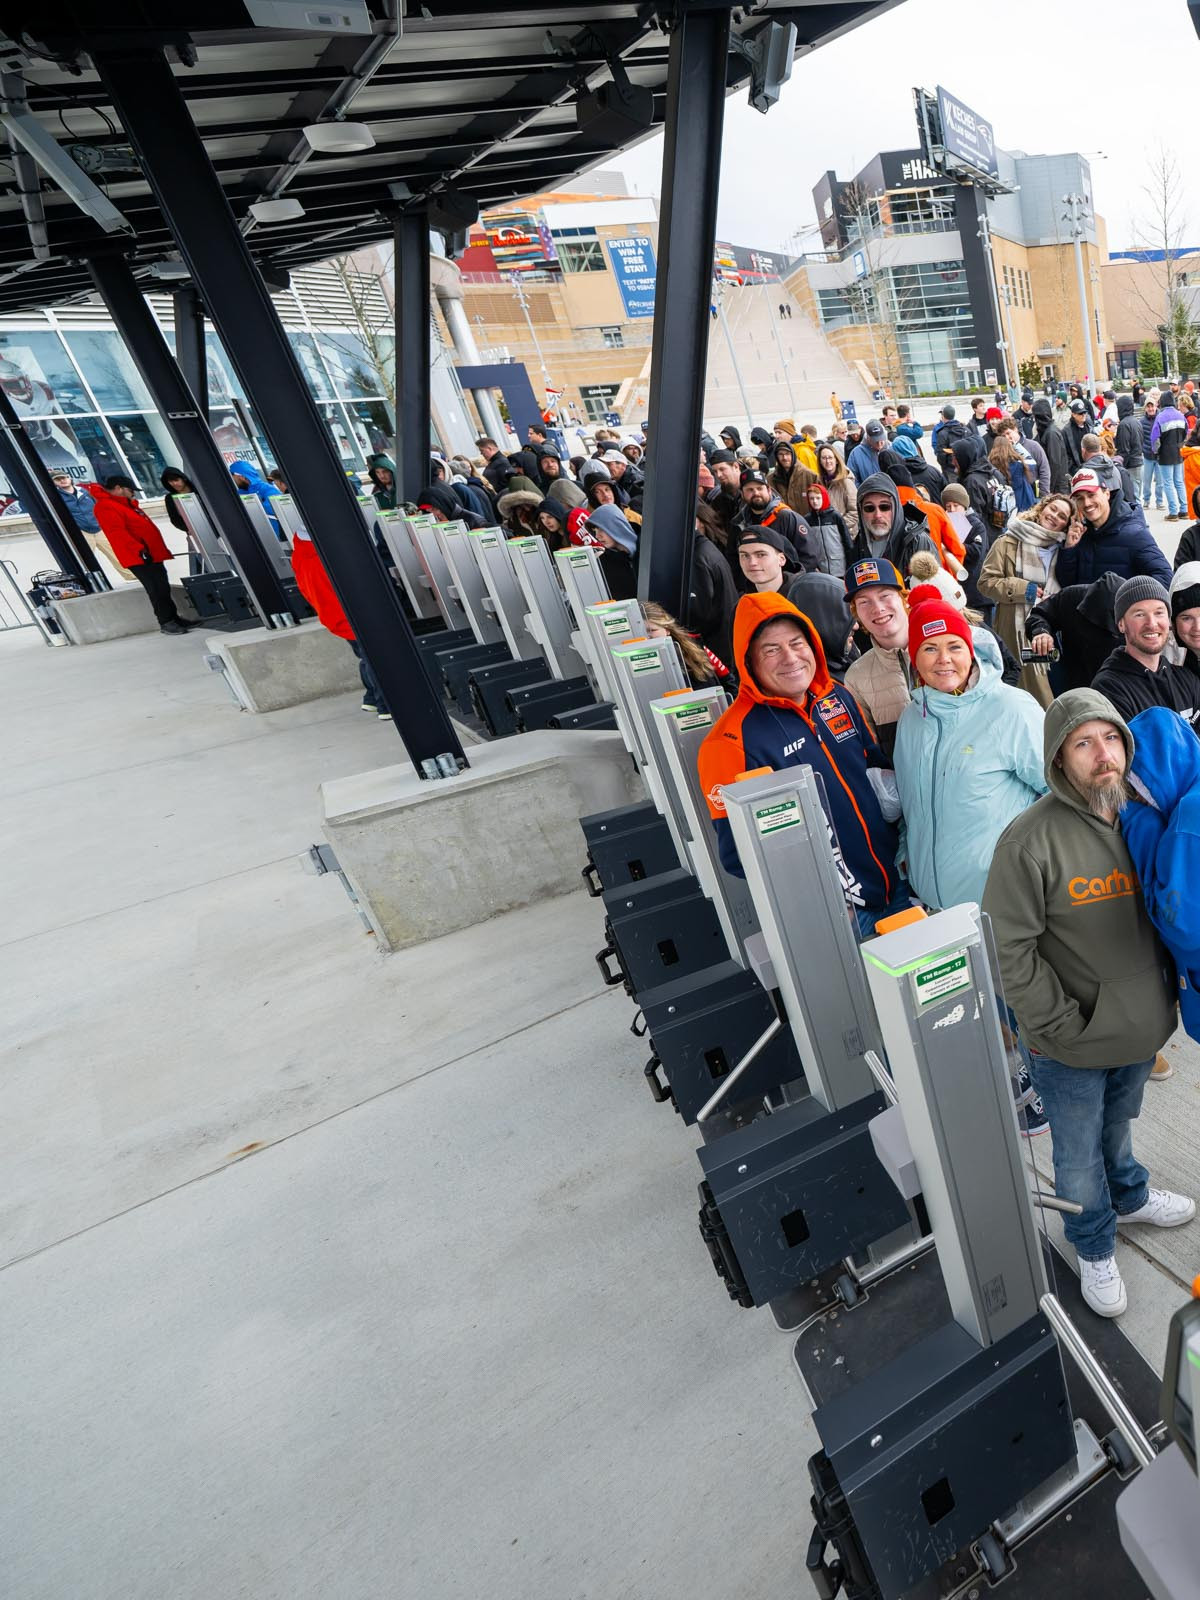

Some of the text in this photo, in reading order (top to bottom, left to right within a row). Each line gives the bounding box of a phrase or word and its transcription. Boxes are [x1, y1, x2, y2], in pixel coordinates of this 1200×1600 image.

[902, 163, 912, 180] THE
[609, 240, 635, 248] ENTER
[623, 256, 644, 264] FREE
[624, 265, 647, 273] STAY!
[933, 966, 952, 978] Ramp
